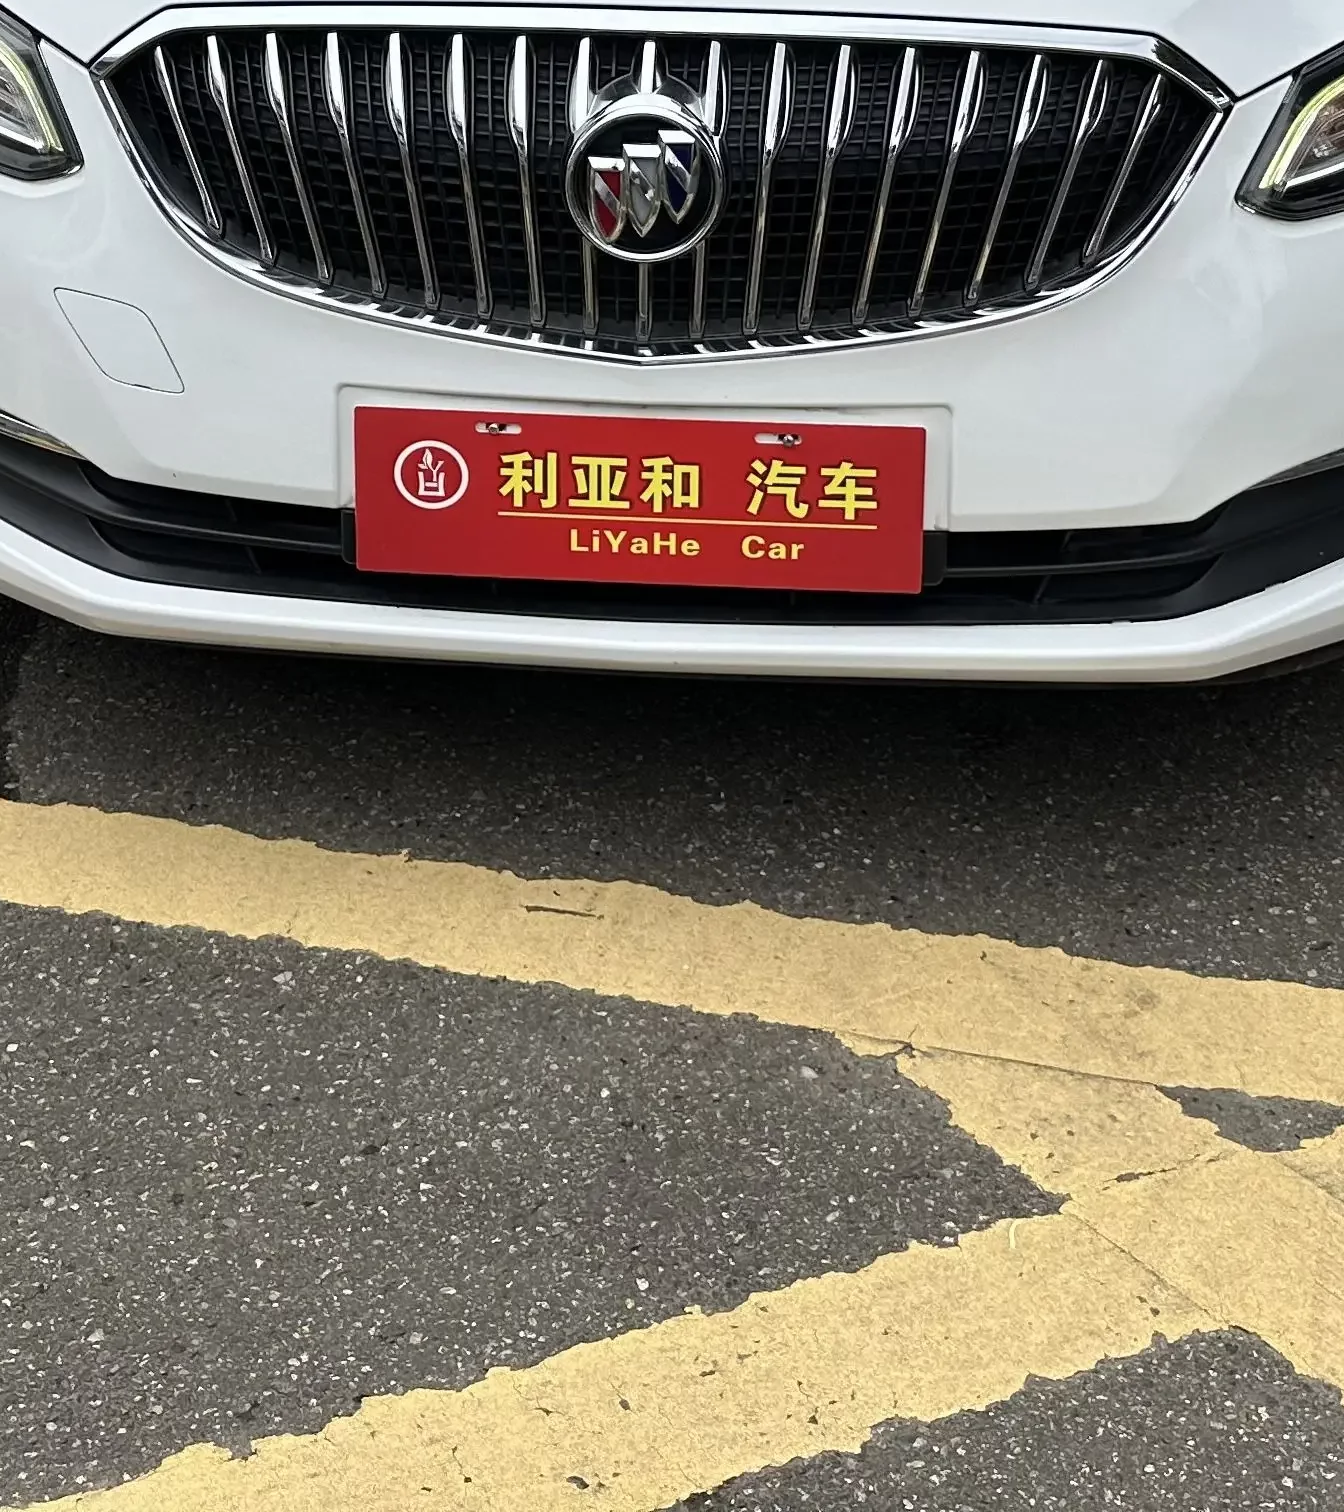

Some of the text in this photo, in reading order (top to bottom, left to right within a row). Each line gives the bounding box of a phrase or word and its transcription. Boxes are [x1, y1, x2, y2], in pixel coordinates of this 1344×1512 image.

[498, 451, 878, 521] 利亚和 汽车
[569, 528, 806, 561] LiYaHe Car
